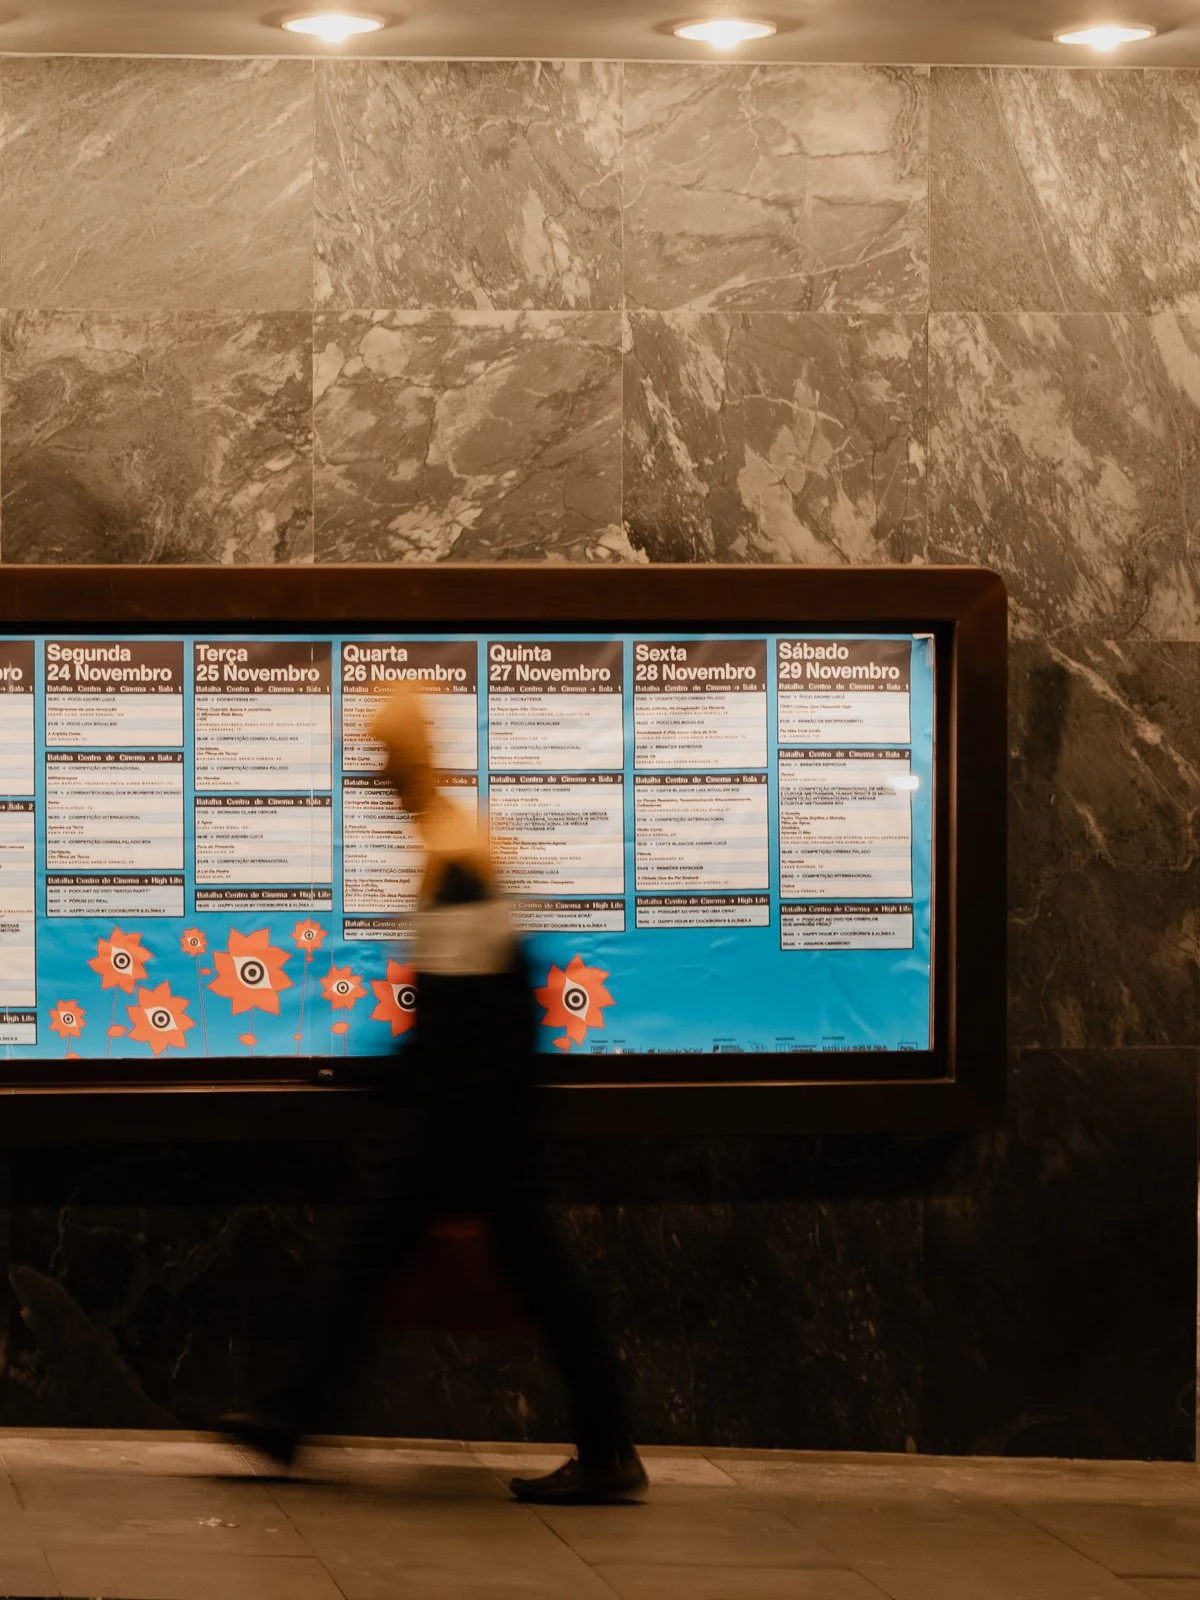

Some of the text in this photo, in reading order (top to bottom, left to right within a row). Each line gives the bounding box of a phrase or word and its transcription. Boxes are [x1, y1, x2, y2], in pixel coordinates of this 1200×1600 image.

[47, 644, 131, 665] Segunda
[196, 644, 248, 666] Terça
[343, 644, 408, 663] Quarta
[490, 644, 551, 663] Quinta
[636, 644, 687, 662] Sexta
[779, 642, 849, 660] Sábado
[47, 664, 172, 681] 24 Novembro
[196, 664, 320, 682] 25 Novembro
[343, 664, 467, 682] 26 Novembro
[490, 664, 611, 682] 27 Novembro
[636, 663, 756, 681] 28 Novembro
[779, 662, 900, 680] 29 Novembro
[47, 685, 73, 693] Batalha
[78, 685, 101, 693] Centro
[106, 685, 115, 693] de
[120, 685, 146, 693] Cinema
[158, 685, 173, 693] Sala
[343, 685, 368, 693] Batalha
[453, 685, 467, 693] Sala
[636, 684, 660, 692] Batalha
[665, 684, 688, 692] Centro
[693, 684, 701, 692] de
[706, 684, 731, 692] Cinema
[743, 684, 757, 692] Sala
[779, 683, 804, 691] Batalha
[809, 683, 831, 691] Centro
[836, 683, 844, 691] de
[849, 683, 874, 691] Cinema
[886, 683, 900, 691] Sala
[490, 776, 622, 784] Batalha Centro de Cinema Sala 2
[29, 803, 33, 811] 2
[48, 877, 182, 885] Batalha Centro de Cinema High Life
[782, 905, 911, 913] Batalha Centro de Cinema High Life
